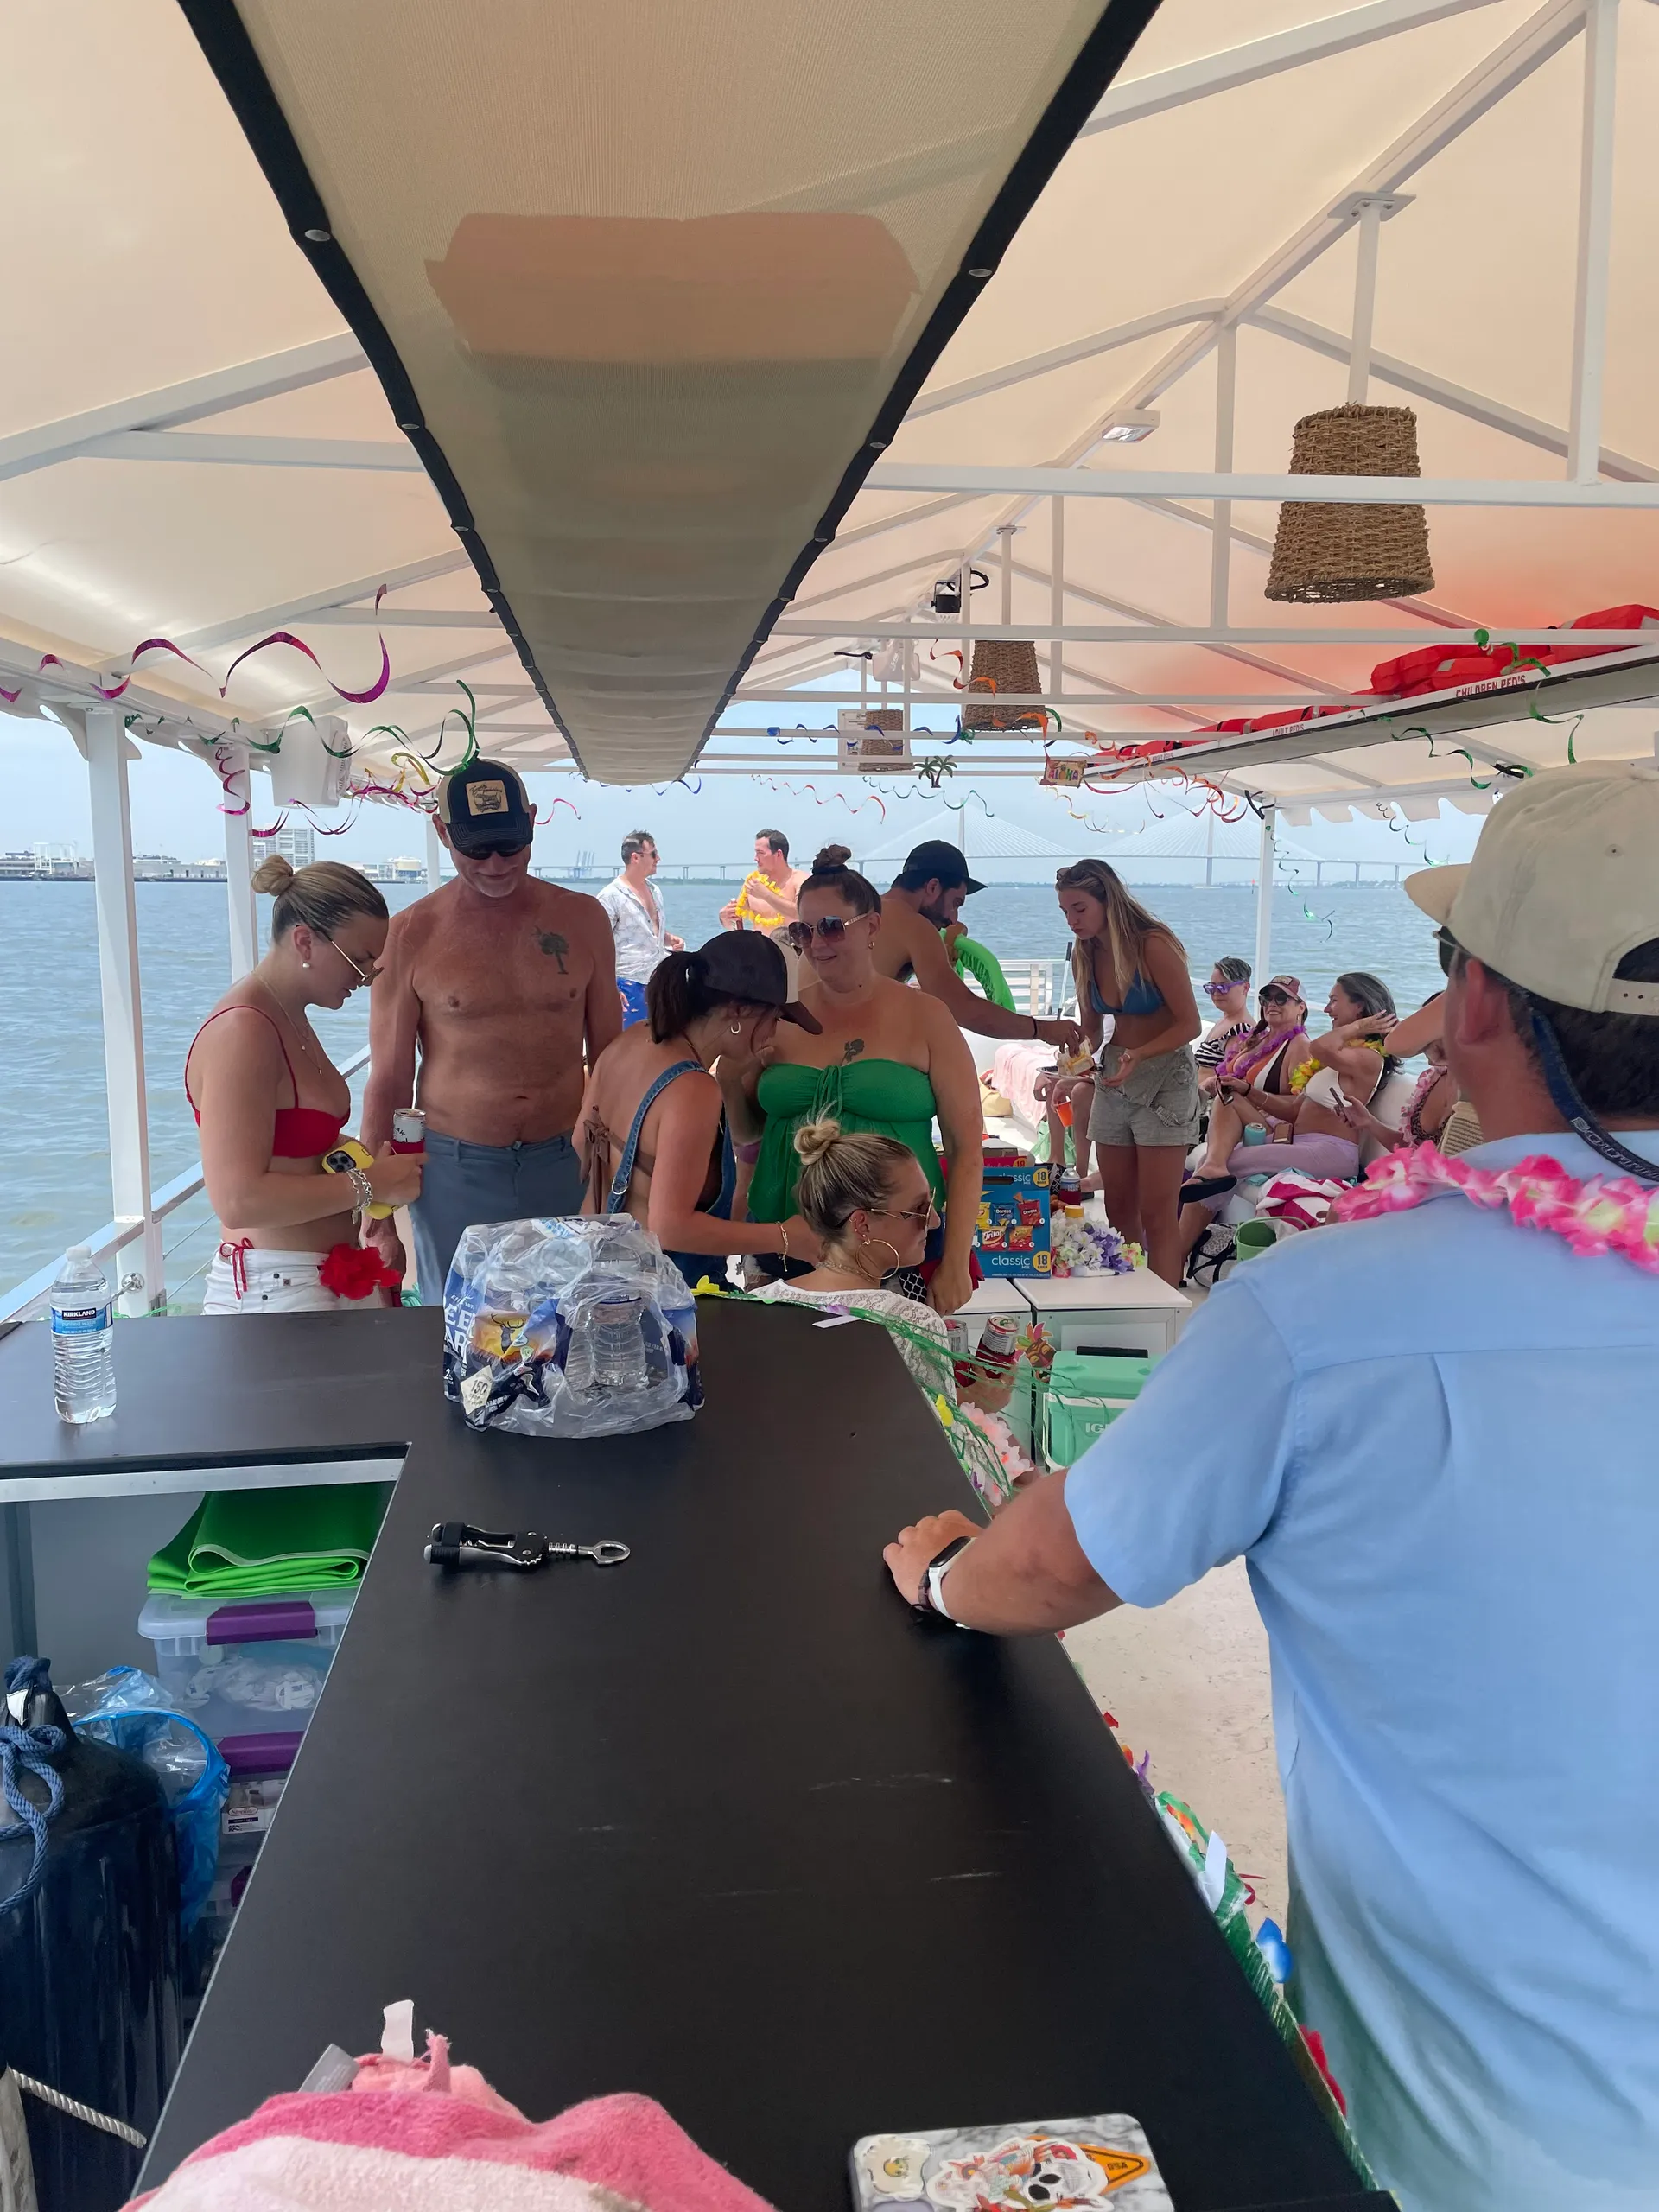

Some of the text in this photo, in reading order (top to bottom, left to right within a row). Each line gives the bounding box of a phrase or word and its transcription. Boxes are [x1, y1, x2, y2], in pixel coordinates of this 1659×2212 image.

[1456, 683, 1498, 698] CHILDREN
[1048, 765, 1079, 782] ALOHA
[1037, 1171, 1046, 1181] 18
[984, 1230, 1003, 1240] Fritos
[991, 1254, 1048, 1266] classic 18
[63, 1309, 96, 1318] KIRKLAND
[471, 1379, 488, 1395] 150
